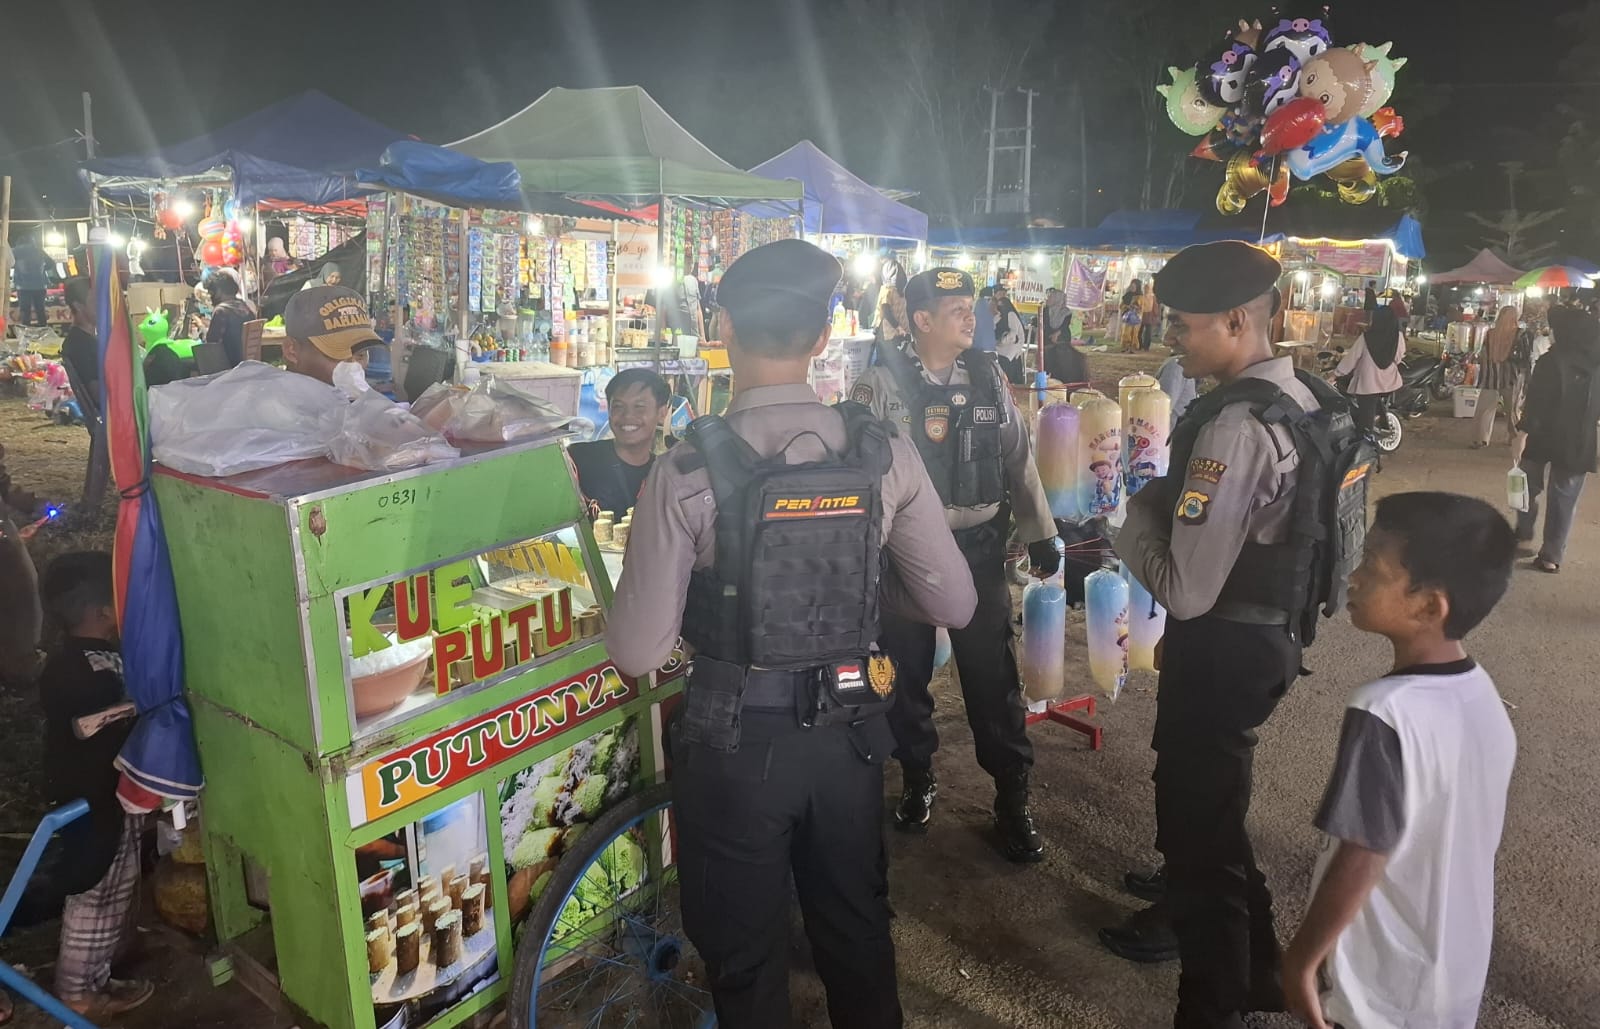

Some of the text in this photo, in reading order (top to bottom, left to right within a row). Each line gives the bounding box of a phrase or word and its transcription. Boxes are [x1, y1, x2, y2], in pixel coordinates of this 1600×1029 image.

[975, 408, 996, 421] POLISI
[349, 559, 474, 659] KUE
[432, 587, 575, 697] PUTU
[376, 665, 630, 807] PUTUNYA
